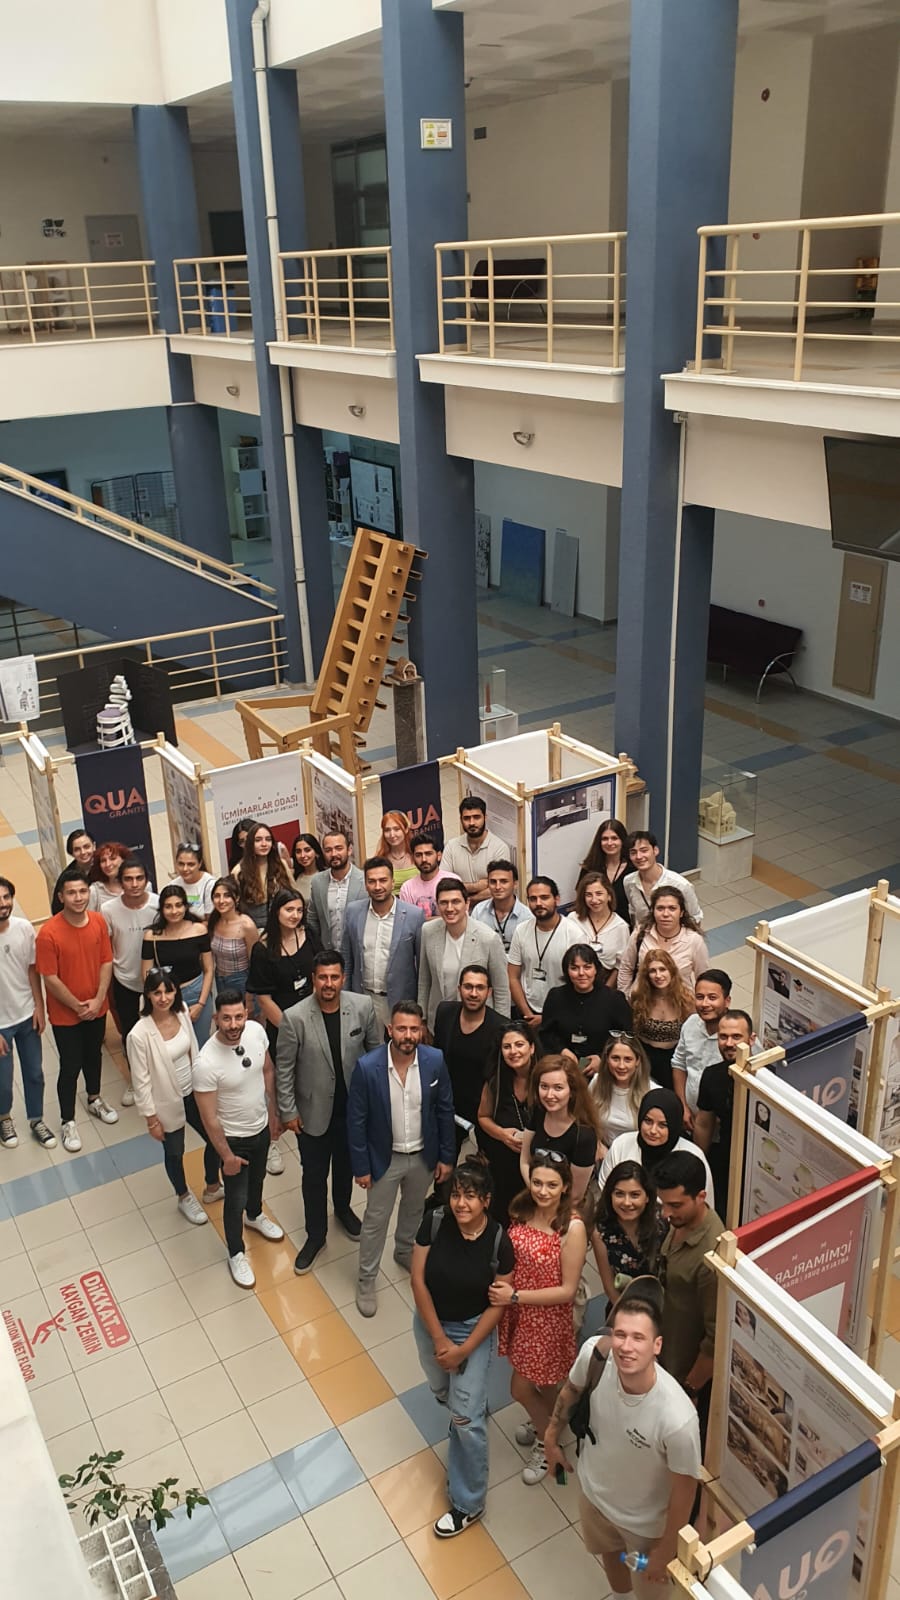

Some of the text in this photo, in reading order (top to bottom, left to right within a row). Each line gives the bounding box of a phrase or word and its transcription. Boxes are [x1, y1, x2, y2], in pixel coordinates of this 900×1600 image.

[84, 786, 145, 815] QUA
[109, 805, 145, 818] GRANITE
[406, 804, 441, 830] UA
[410, 823, 441, 837] RANITE
[59, 1282, 90, 1324] KAYGAN
[2, 1310, 36, 1383] CAUTION WET FLOOR
